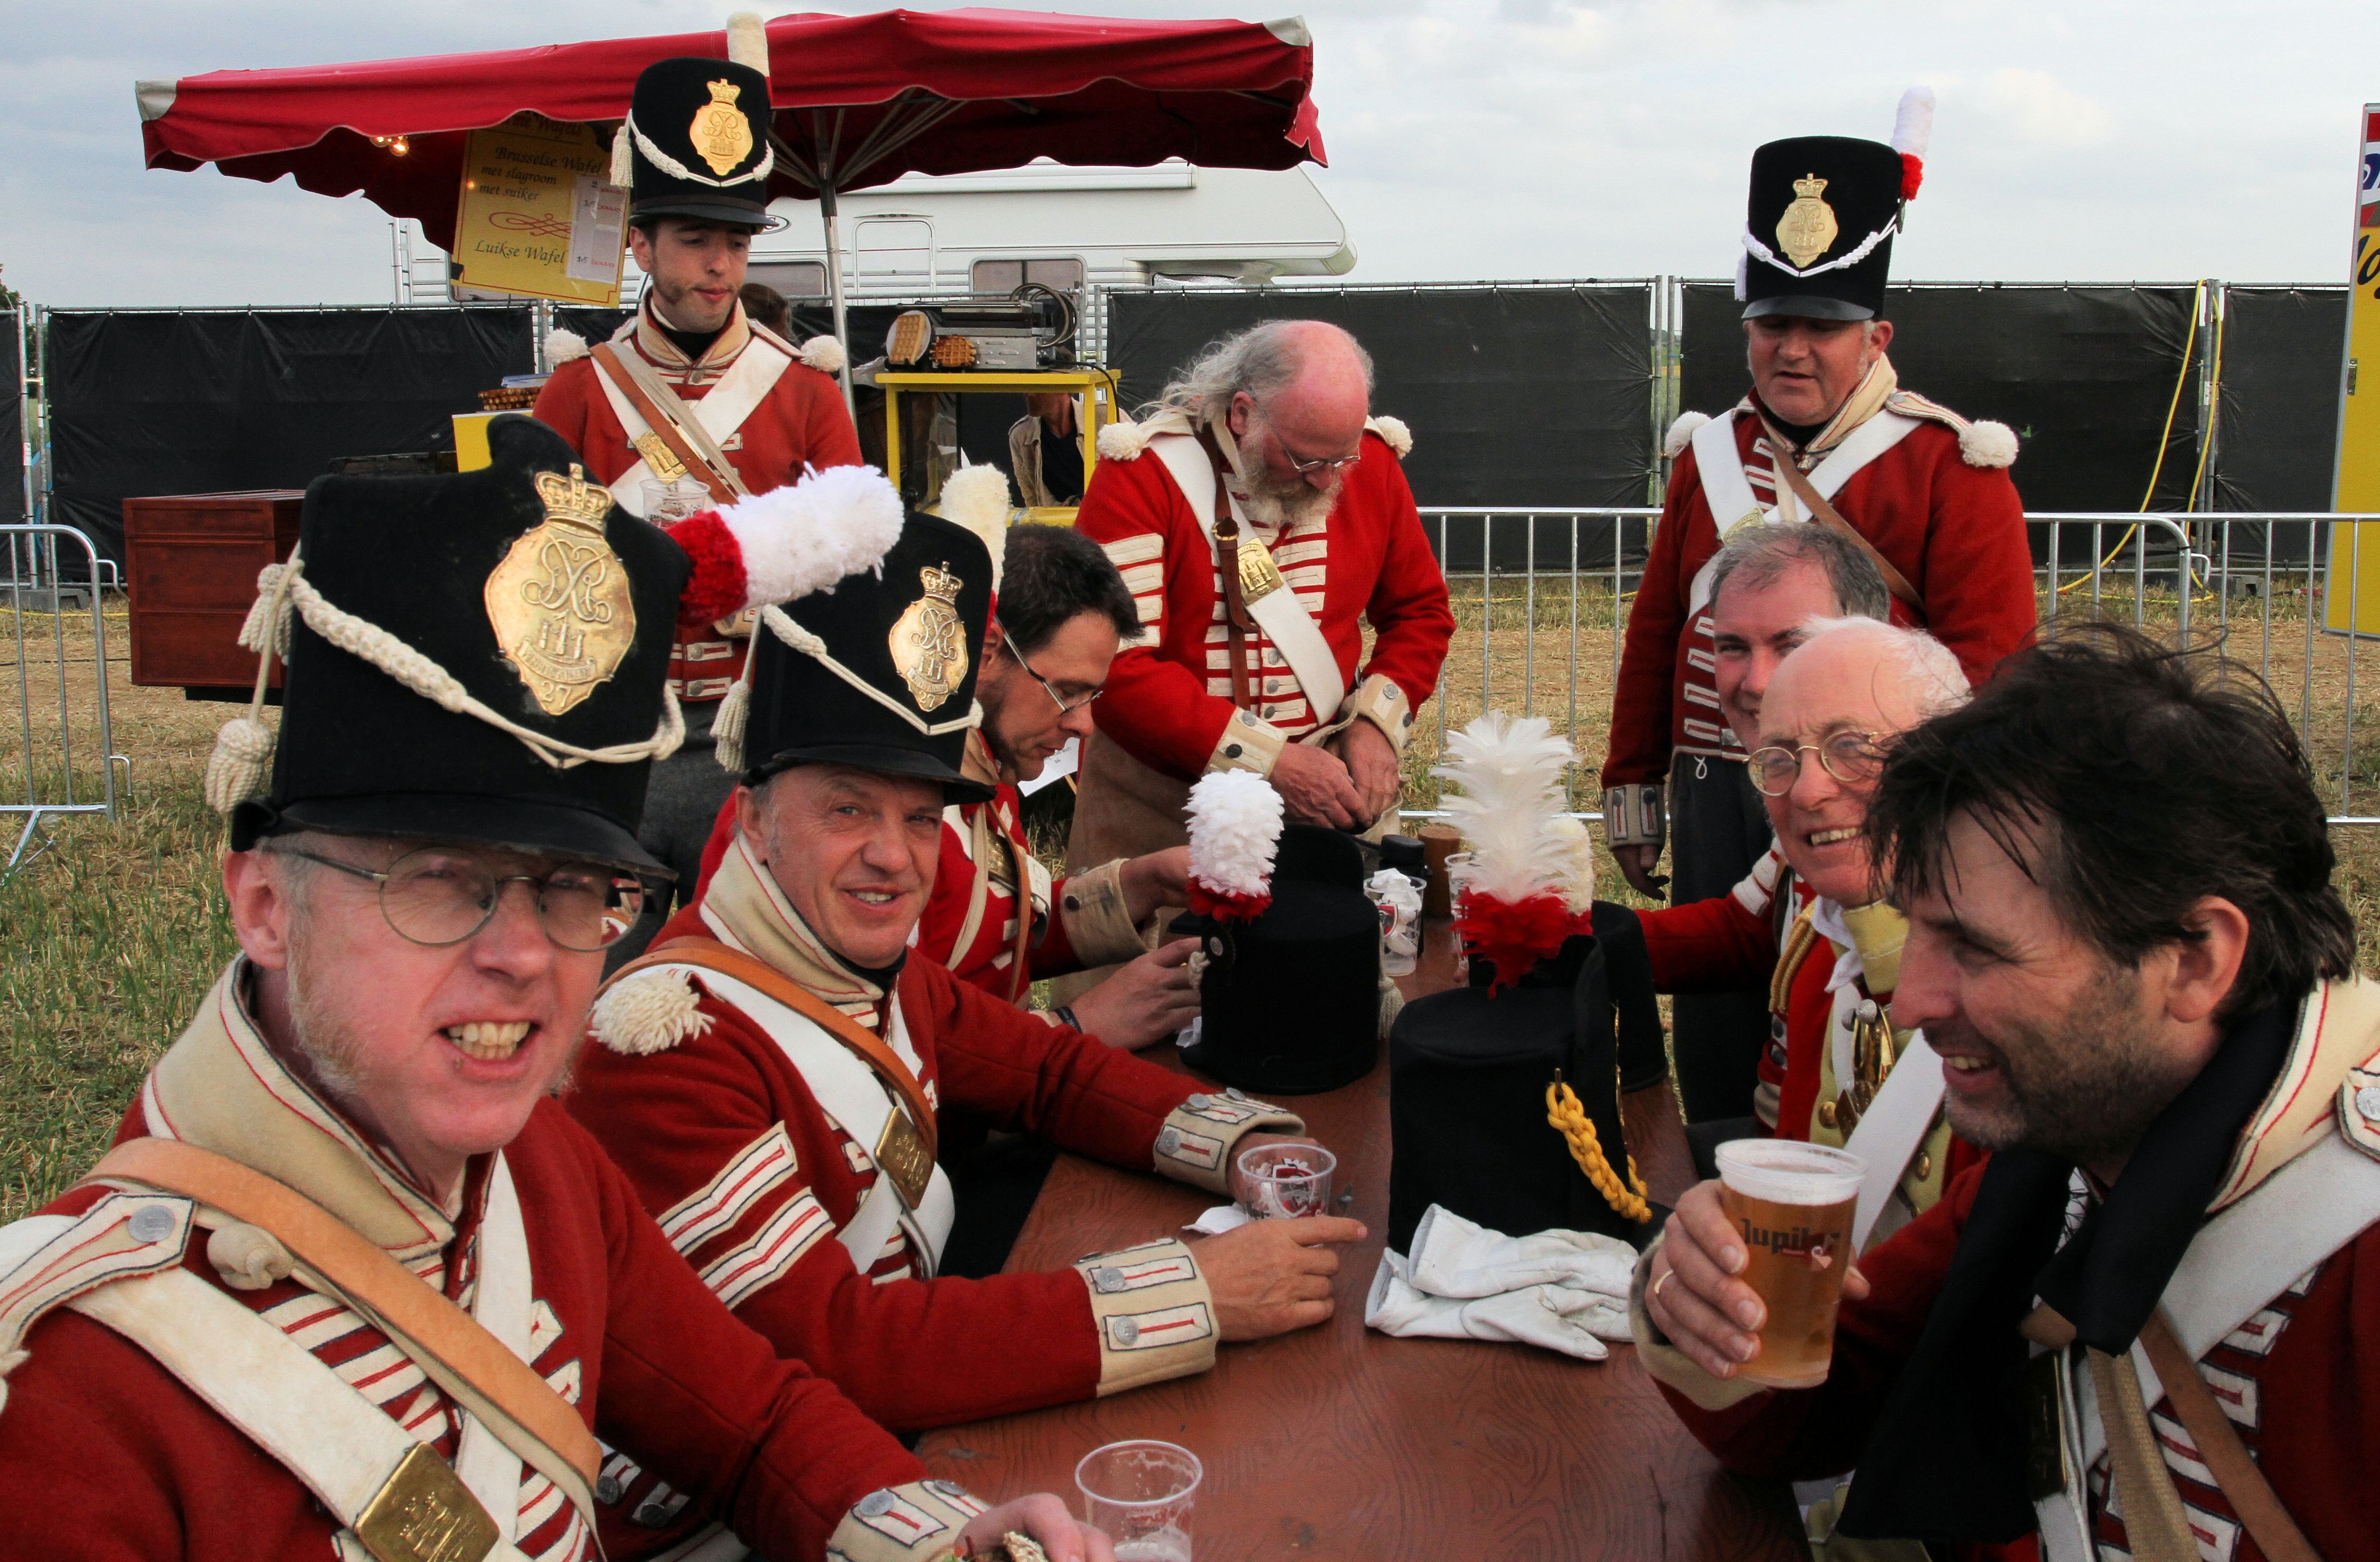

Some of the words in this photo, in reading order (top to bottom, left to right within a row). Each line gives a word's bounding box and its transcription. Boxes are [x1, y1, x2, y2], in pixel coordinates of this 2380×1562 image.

[494, 147, 557, 169] Brusselse
[561, 156, 605, 175] Wafel
[480, 165, 502, 177] met
[505, 166, 557, 184] slagroom
[479, 184, 500, 195] met
[503, 186, 540, 202] suiker
[475, 240, 520, 259] Luikse
[524, 247, 566, 266] Wafel
[540, 680, 572, 708] 27
[919, 690, 937, 708] 27
